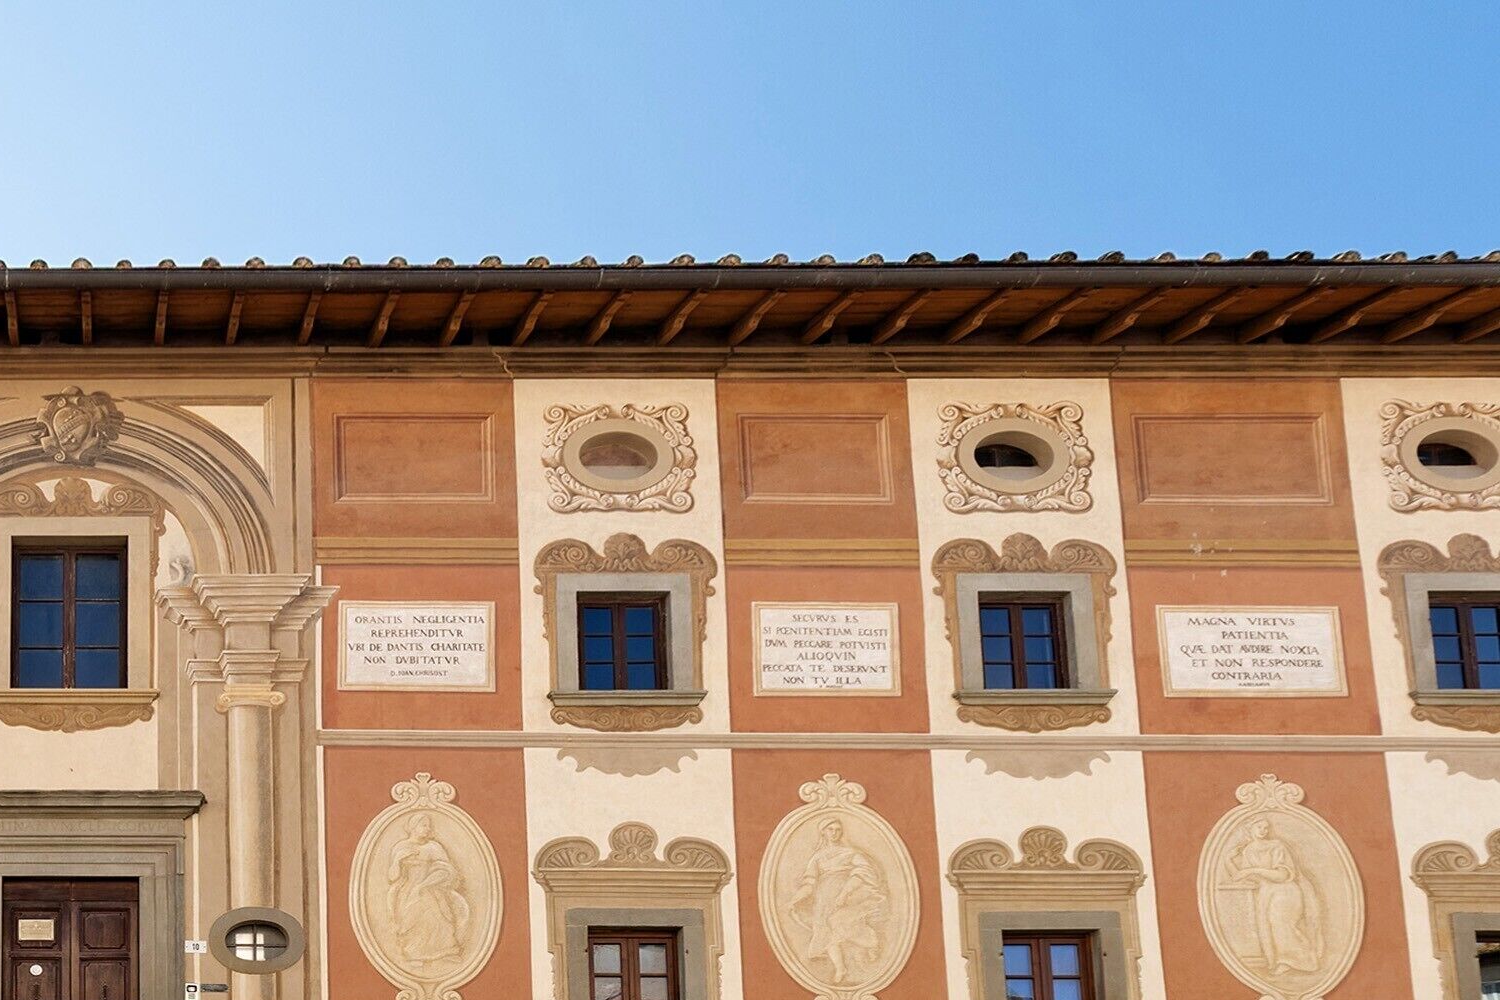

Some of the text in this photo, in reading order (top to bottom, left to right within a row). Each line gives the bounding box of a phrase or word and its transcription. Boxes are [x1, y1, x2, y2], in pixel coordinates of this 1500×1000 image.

[355, 616, 485, 624] ORANTIS NEGLIGENTIA
[792, 615, 859, 623] SECVRVS ES
[1187, 617, 1295, 626] MAGNA VIRTVS
[370, 629, 464, 638] REPREHENDITVR
[1222, 631, 1289, 640] PATIENTIA
[348, 643, 485, 652] VBI DE DANTIS CHARITATE
[765, 640, 887, 650] DVM PECCARE POTVISTI
[1211, 645, 1234, 654] DAT
[1280, 645, 1320, 655] NOXIA
[363, 656, 460, 665] NON DVBITATVR
[797, 652, 857, 662] ALIOQVIN
[1192, 659, 1324, 668] ET NON RESPONDERE
[763, 664, 888, 673] PECCATA TE DESERVNT
[783, 676, 862, 685] NON TV ILLA
[1211, 672, 1282, 680] CONTRARIA
